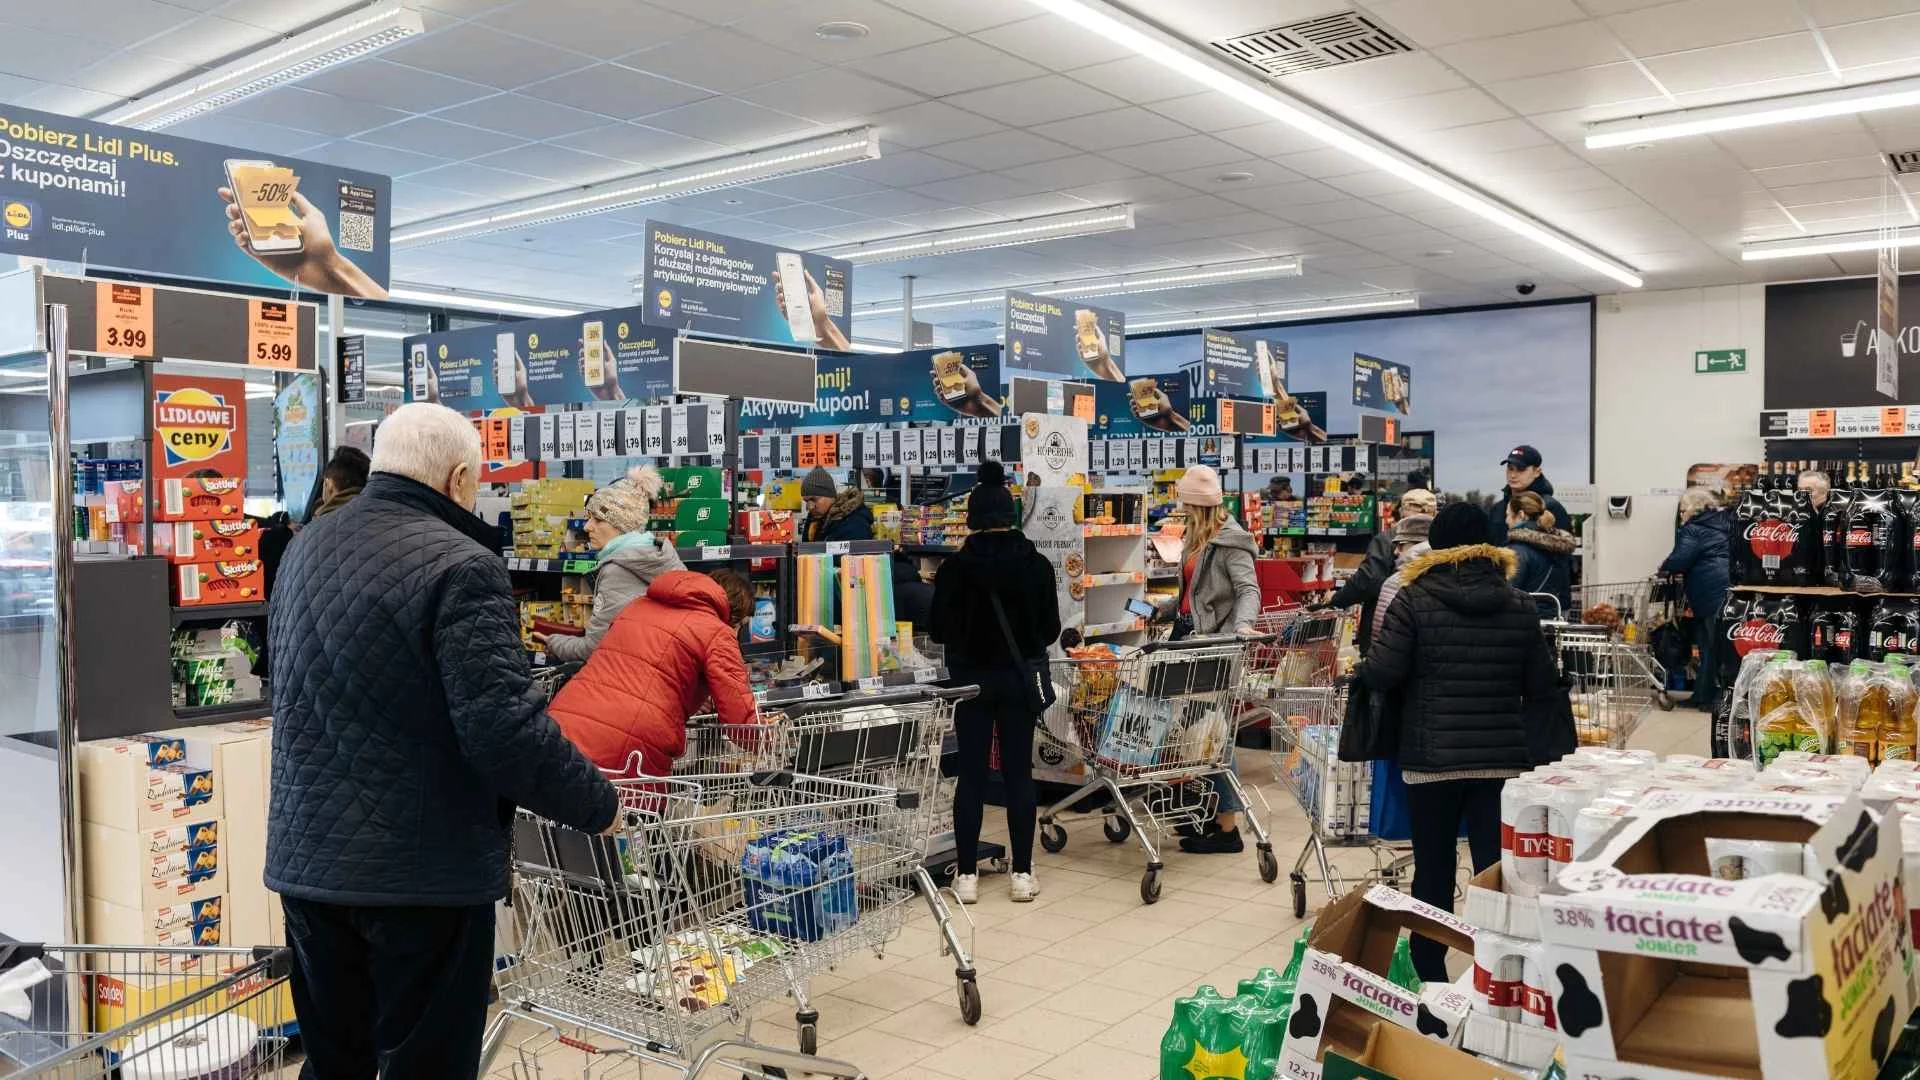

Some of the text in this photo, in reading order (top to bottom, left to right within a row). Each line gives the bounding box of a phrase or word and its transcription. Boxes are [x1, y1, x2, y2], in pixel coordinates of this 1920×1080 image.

[0, 117, 180, 166] Pobierz Lidl Plus.
[0, 139, 117, 179] Oszczędzaj
[11, 163, 127, 197] kuponami!
[251, 183, 289, 203] -50%
[7, 228, 29, 241] Plus
[655, 231, 726, 255] Pobierz Lidl Plus.
[654, 244, 754, 272] Korzystaj z e-paragonów
[653, 269, 696, 285] artykułów
[659, 257, 693, 274] dłuższej
[695, 265, 739, 281] możliwości
[741, 274, 767, 286] zwrotu
[107, 327, 146, 348] 3.99
[257, 342, 292, 362] 5.99
[160, 406, 230, 425] LIDLOWE
[171, 431, 219, 448] ceny
[579, 439, 594, 452] 1.29
[602, 439, 615, 449] 1.29
[626, 438, 640, 449] 1.79
[647, 436, 661, 448] 1.79
[709, 433, 723, 446] 1.79
[903, 450, 917, 461] 1.29
[926, 450, 937, 460] 1.29
[943, 449, 955, 459] 1.79
[206, 479, 238, 492] Skittles
[218, 521, 252, 534] Skittles
[1743, 521, 1802, 543] Coca-Cola
[223, 563, 257, 577] Skittles
[1727, 622, 1789, 644] Coca-Cola
[171, 639, 195, 649] HALLS
[198, 665, 224, 676] HALLS
[208, 687, 233, 697] HALLS
[1553, 905, 1725, 945] 3.8% łaciate
[1341, 971, 1415, 1016] łaciate
[1355, 995, 1394, 1018] JUNIOR
